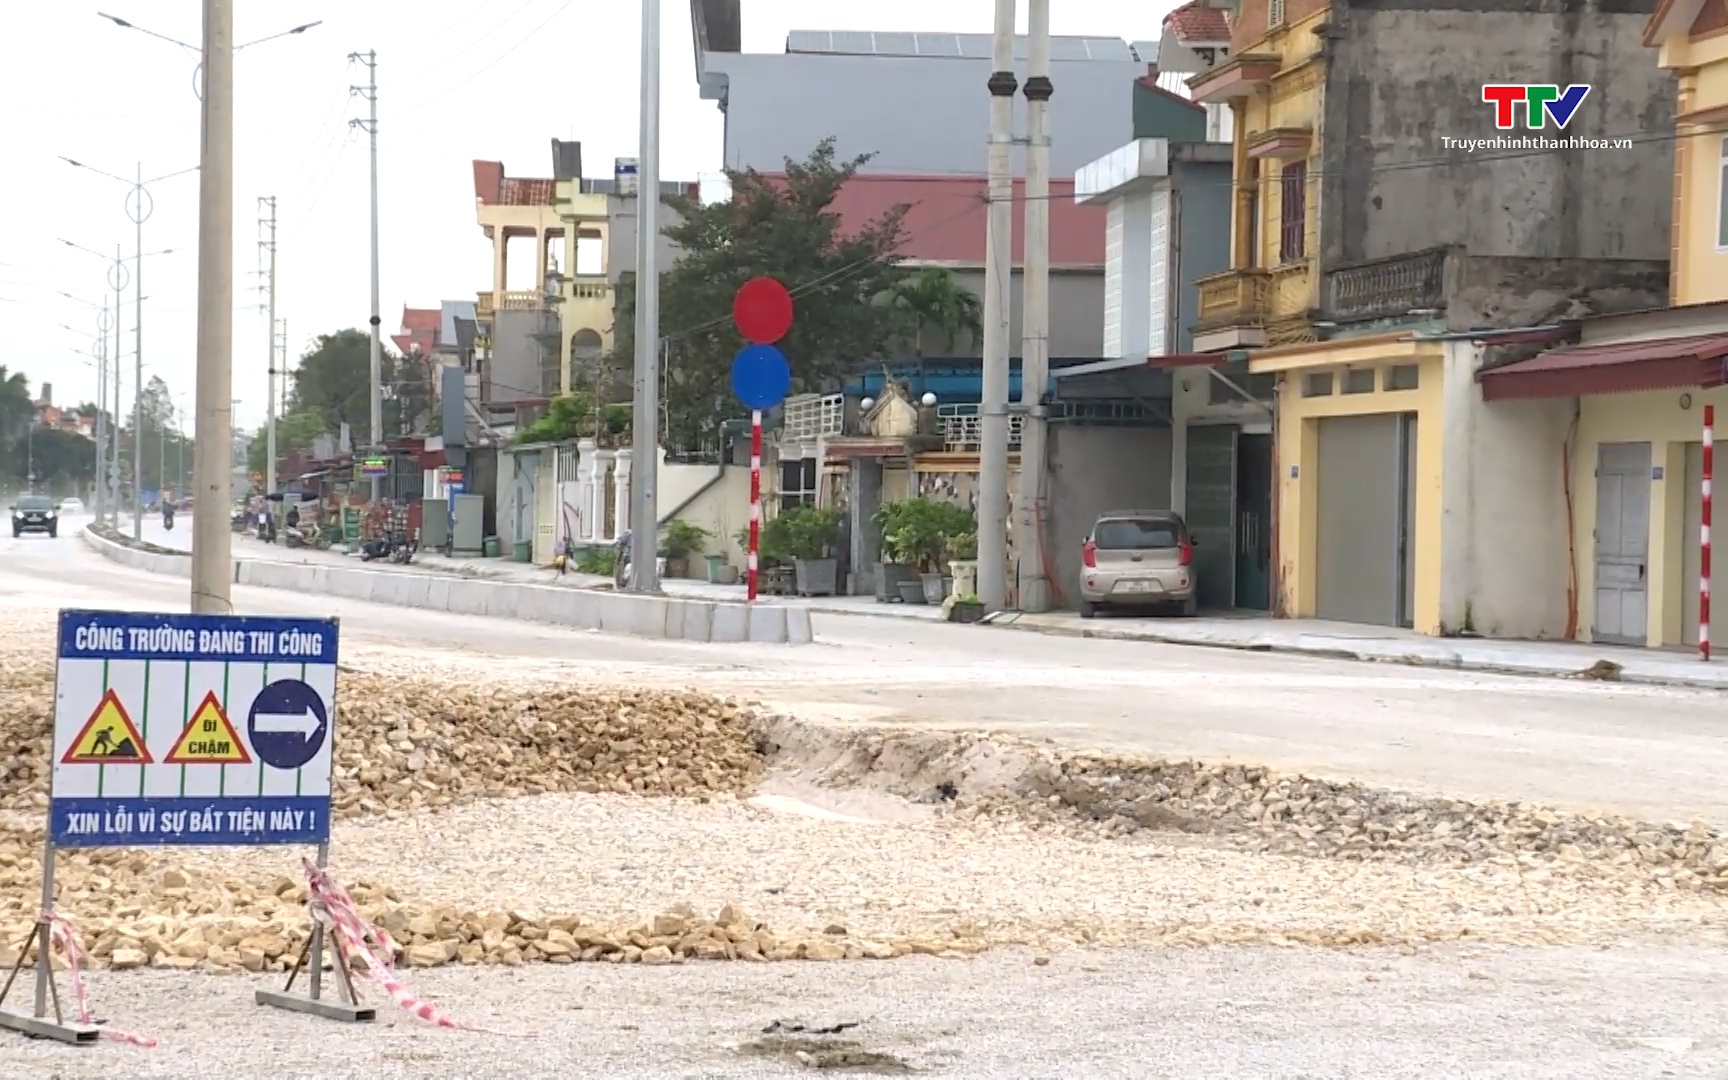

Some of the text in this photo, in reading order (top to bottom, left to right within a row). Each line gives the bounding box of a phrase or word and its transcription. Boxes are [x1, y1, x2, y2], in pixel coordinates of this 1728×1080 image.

[75, 622, 322, 656] CÔNG TRƯỜNG ĐANG THI CÔNG
[203, 719, 217, 732] ĐI
[66, 803, 316, 836] XIN LỖI VÌ SỰ BẤT TIỆN NÀY !
